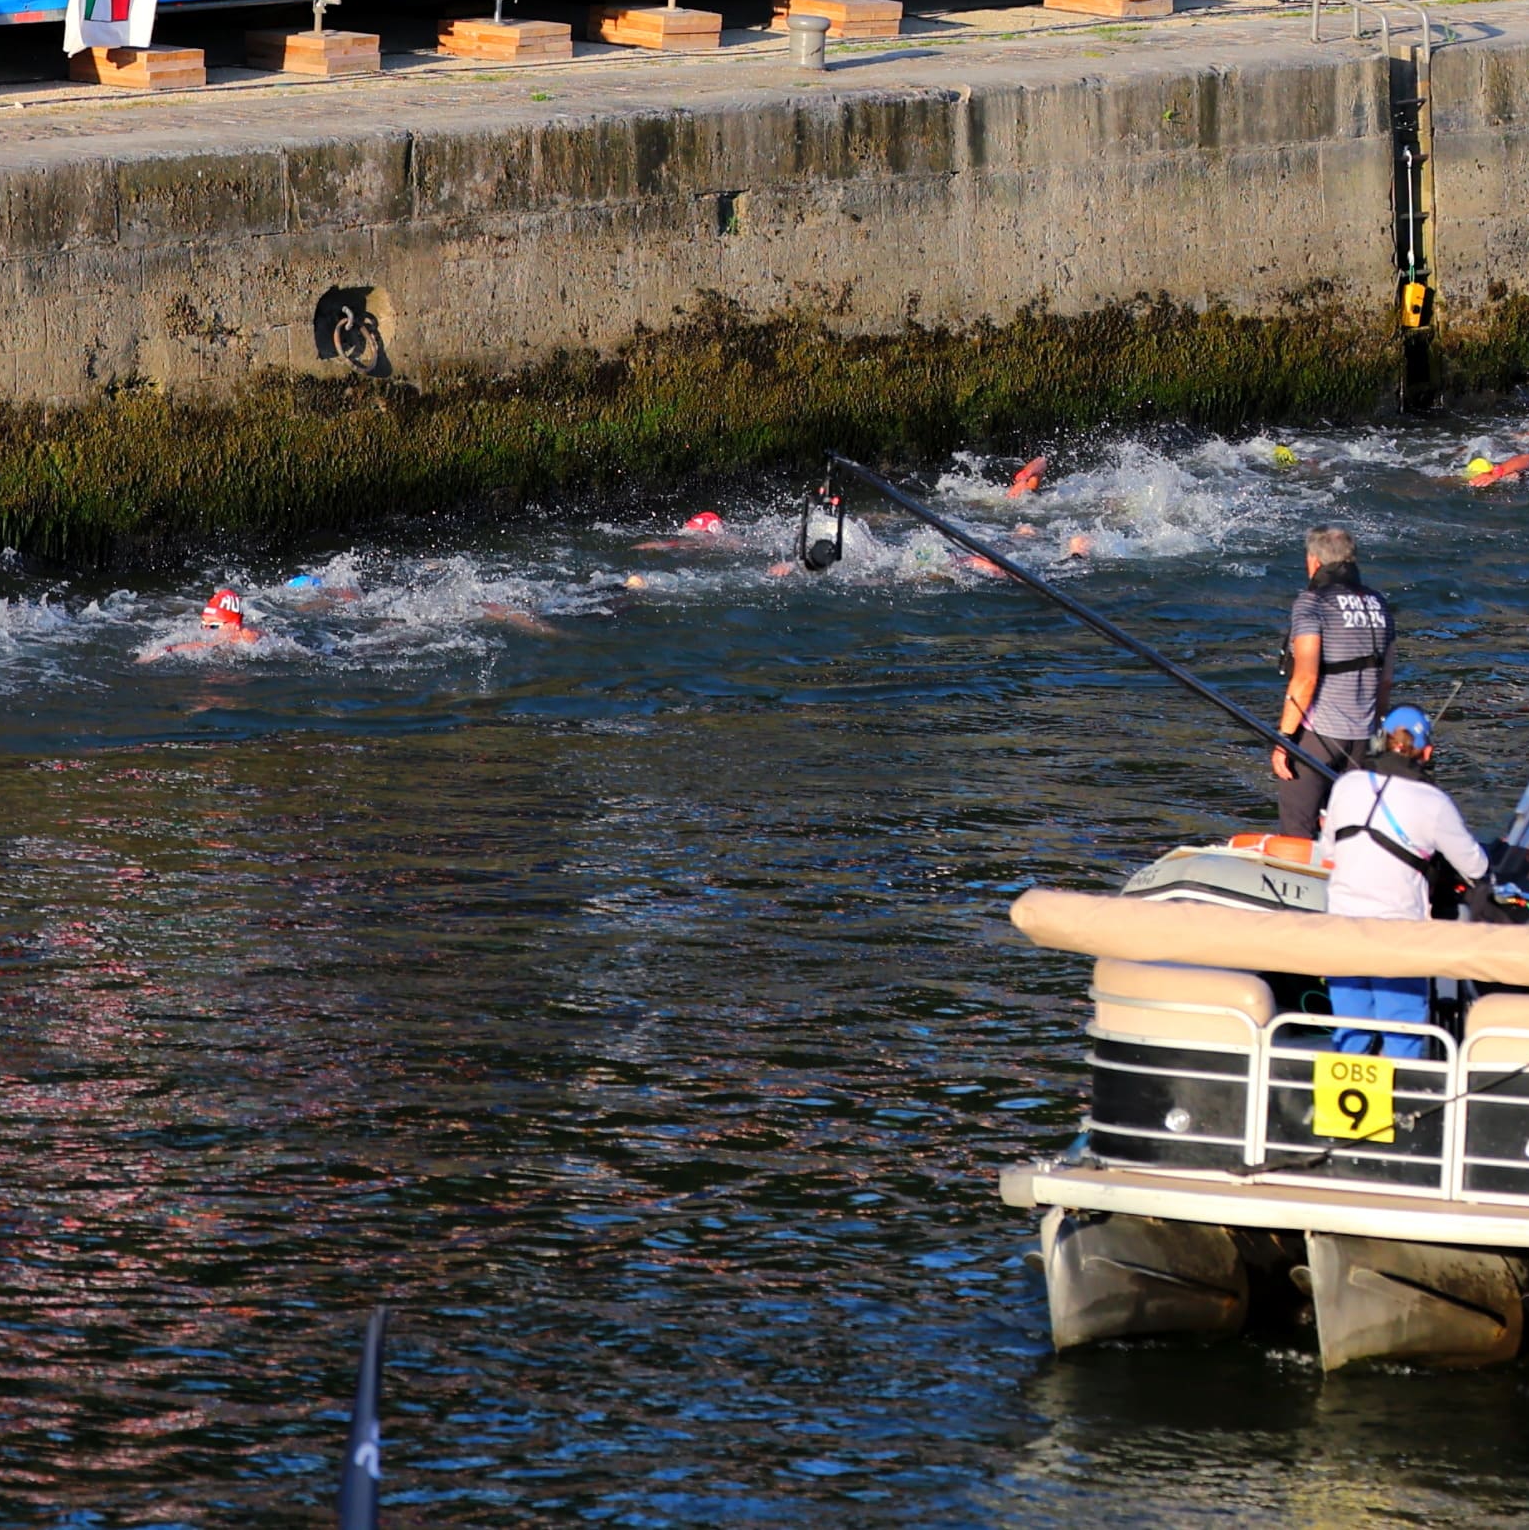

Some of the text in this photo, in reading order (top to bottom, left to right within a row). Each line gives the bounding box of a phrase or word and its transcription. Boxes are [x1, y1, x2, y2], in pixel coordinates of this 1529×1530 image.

[1260, 874, 1309, 900] NIF
[1331, 1062, 1378, 1084] OBS
[1338, 1088, 1369, 1132] 9
